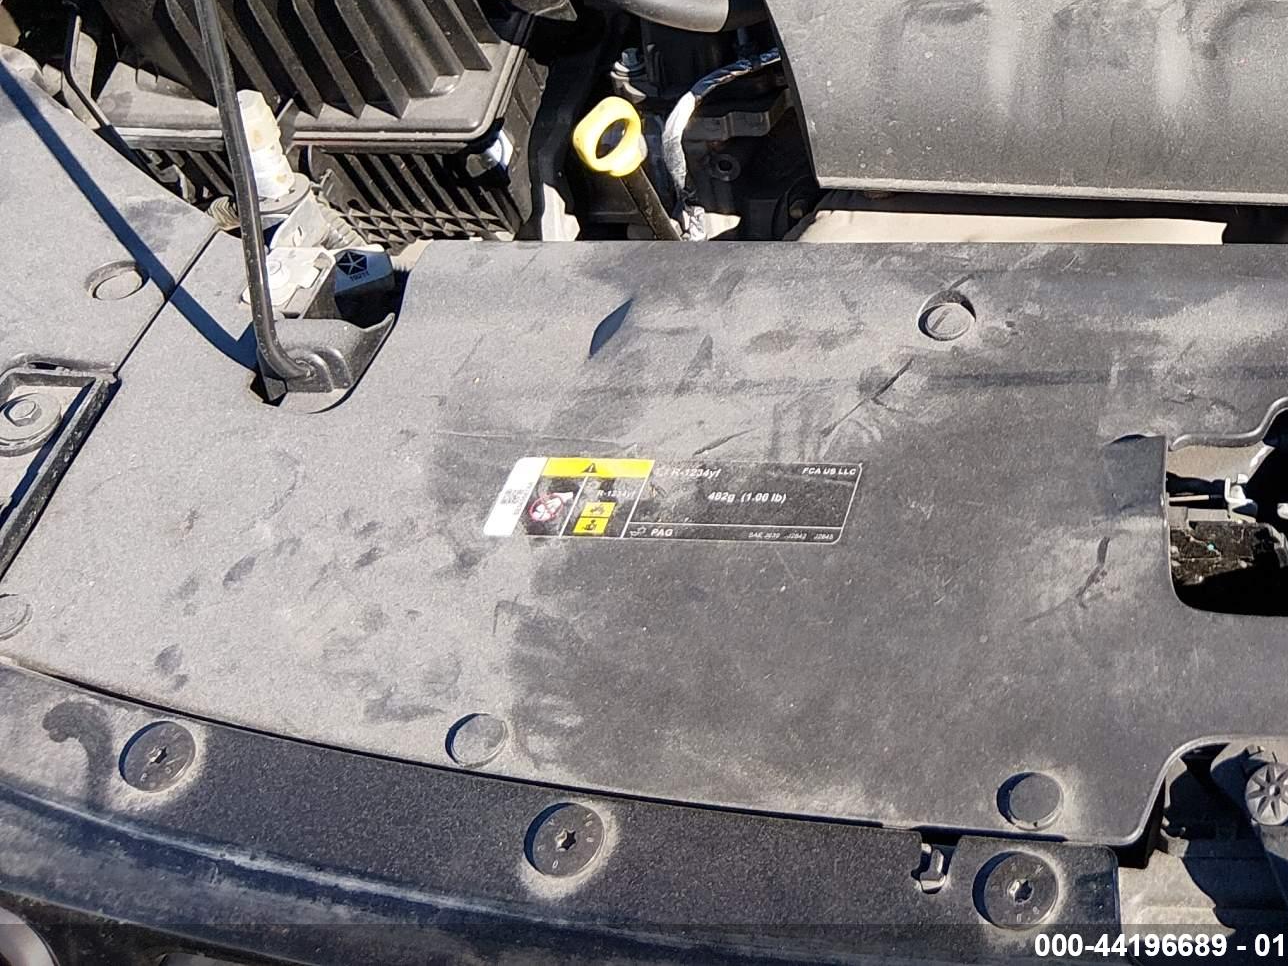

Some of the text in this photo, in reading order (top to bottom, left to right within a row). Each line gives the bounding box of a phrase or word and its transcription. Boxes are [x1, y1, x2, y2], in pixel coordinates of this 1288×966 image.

[671, 468, 721, 478] R-1234yf
[802, 467, 857, 476] FCA US LLC
[650, 528, 673, 537] PAG
